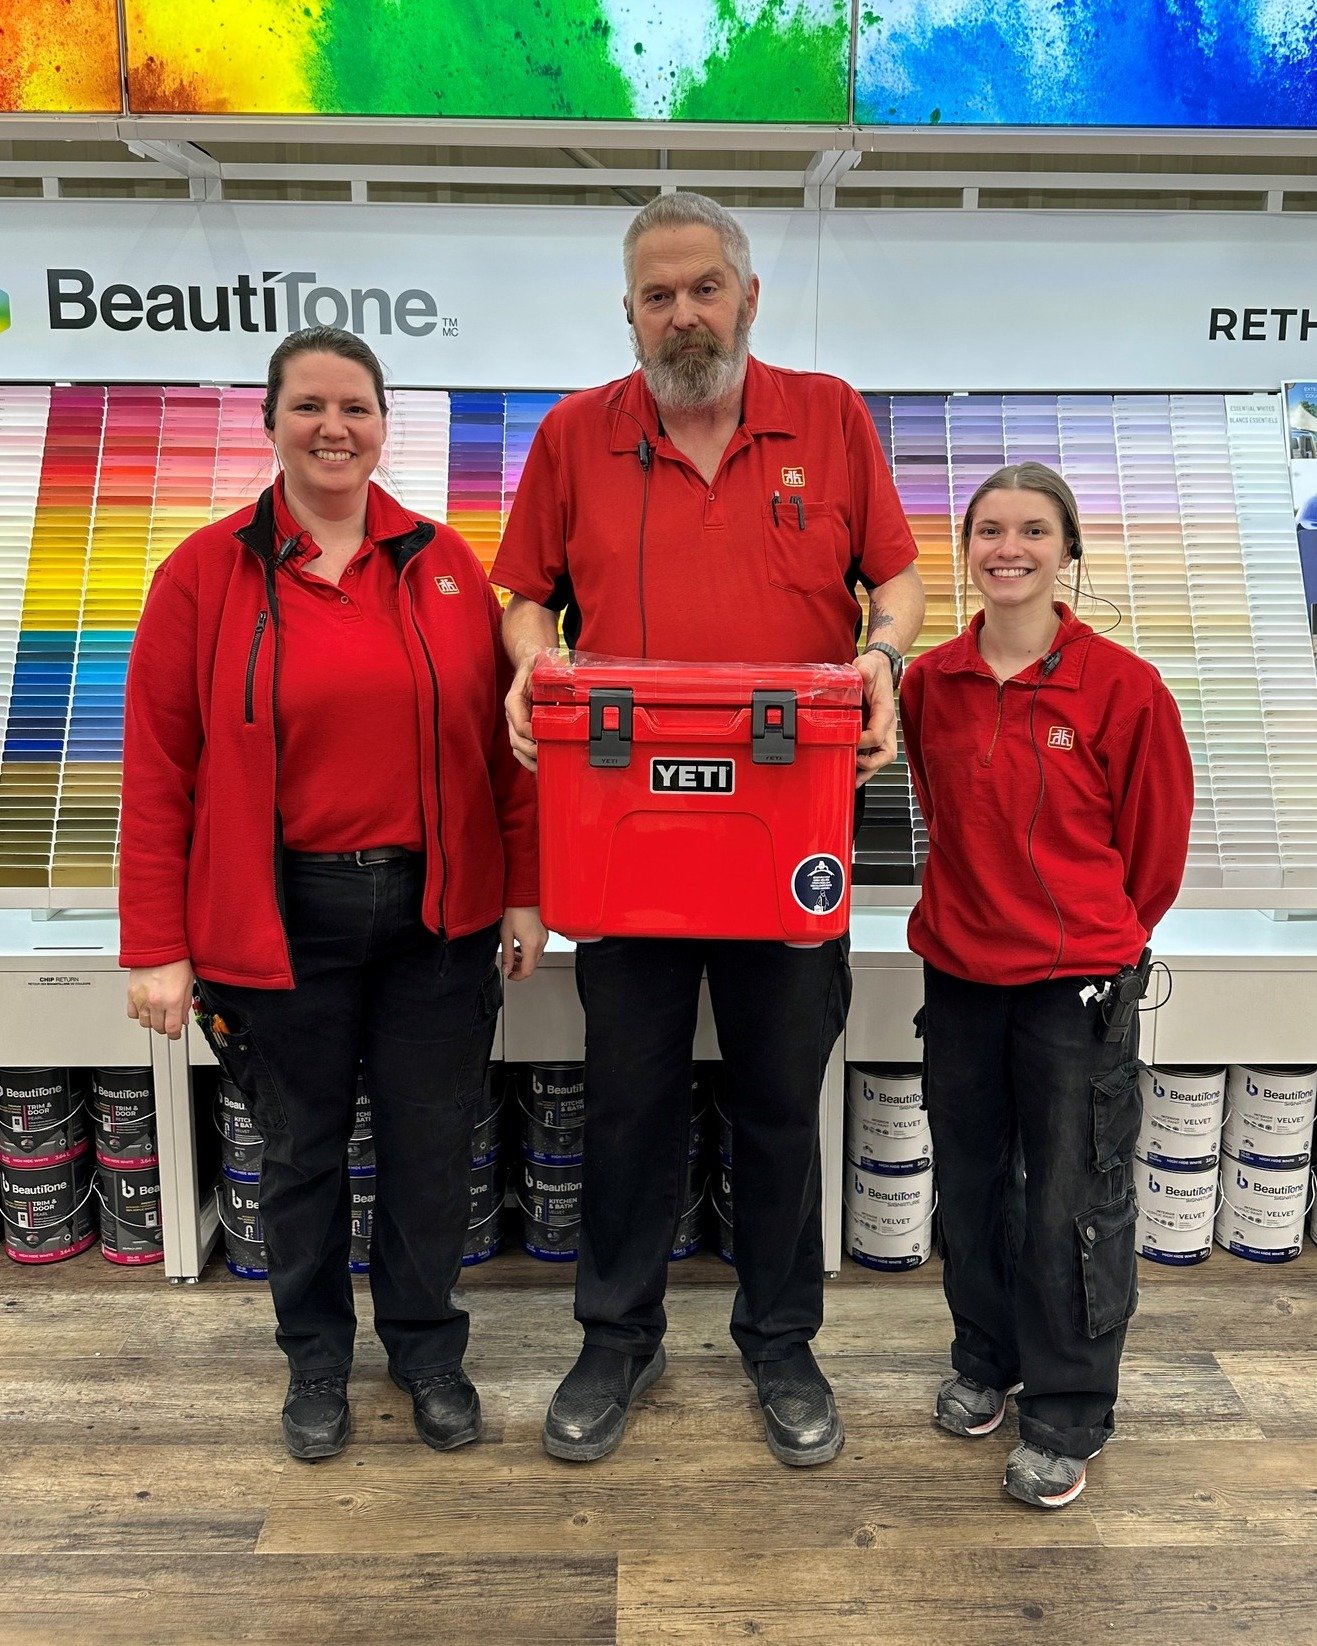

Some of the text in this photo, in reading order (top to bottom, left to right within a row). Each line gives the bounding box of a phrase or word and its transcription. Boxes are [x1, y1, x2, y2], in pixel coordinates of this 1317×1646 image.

[46, 268, 438, 337] BeautiTone
[442, 317, 458, 327] TM
[442, 327, 459, 337] MC
[656, 765, 727, 788] YETI
[6, 1085, 62, 1098] BeautiTone
[99, 1086, 149, 1098] BeautiTone
[1170, 1090, 1220, 1101] BeautiTone
[1264, 1089, 1313, 1100] BeautiTone
[893, 1119, 921, 1128] VELVET
[12, 1182, 67, 1194] BeautiTone
[1166, 1185, 1213, 1196] BeautiTone
[1254, 1183, 1303, 1194] BeautiTone
[868, 1188, 920, 1200] BeautiTone
[1179, 1211, 1205, 1219] VELVET
